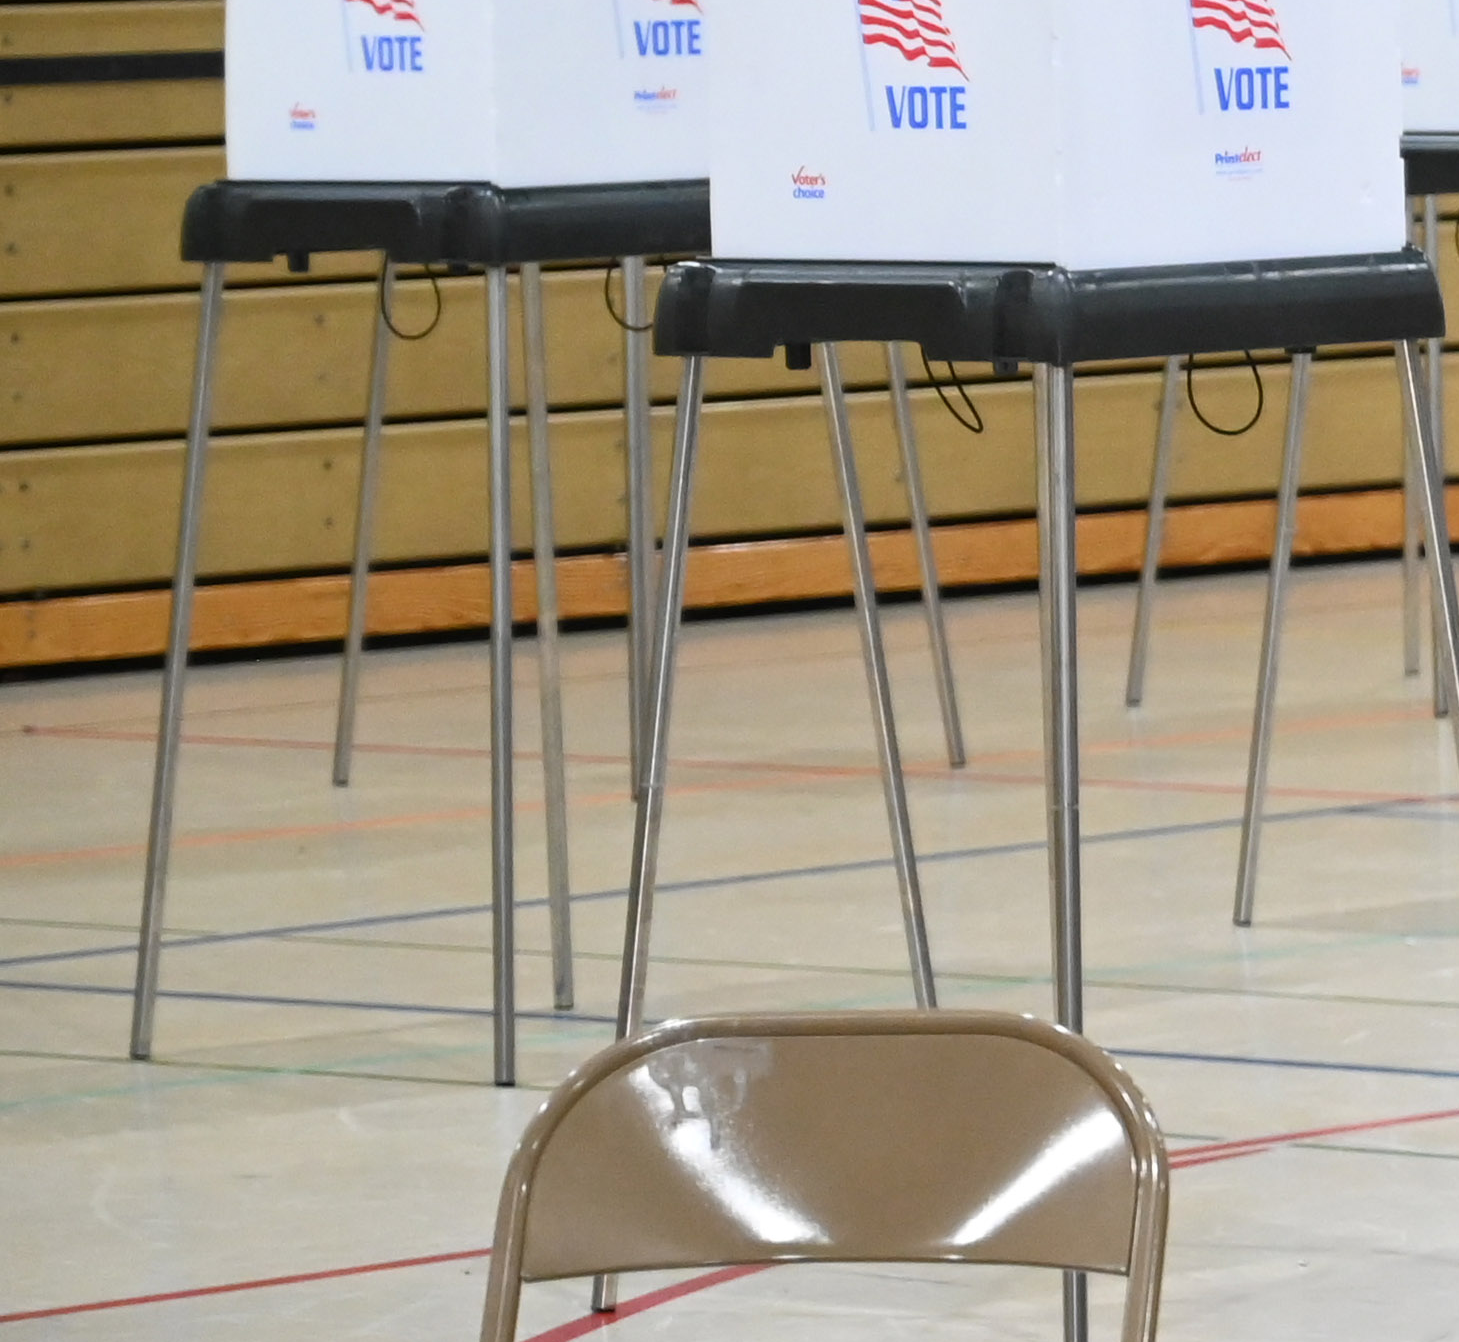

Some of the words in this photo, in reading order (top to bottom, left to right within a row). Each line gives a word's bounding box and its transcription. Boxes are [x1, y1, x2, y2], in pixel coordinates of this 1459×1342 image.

[360, 35, 423, 72] VOTE
[633, 19, 702, 57] VOTE
[1214, 65, 1290, 112] VOTE
[885, 85, 968, 130] VOTE
[791, 164, 827, 186] Voter's
[792, 186, 826, 199] choice
